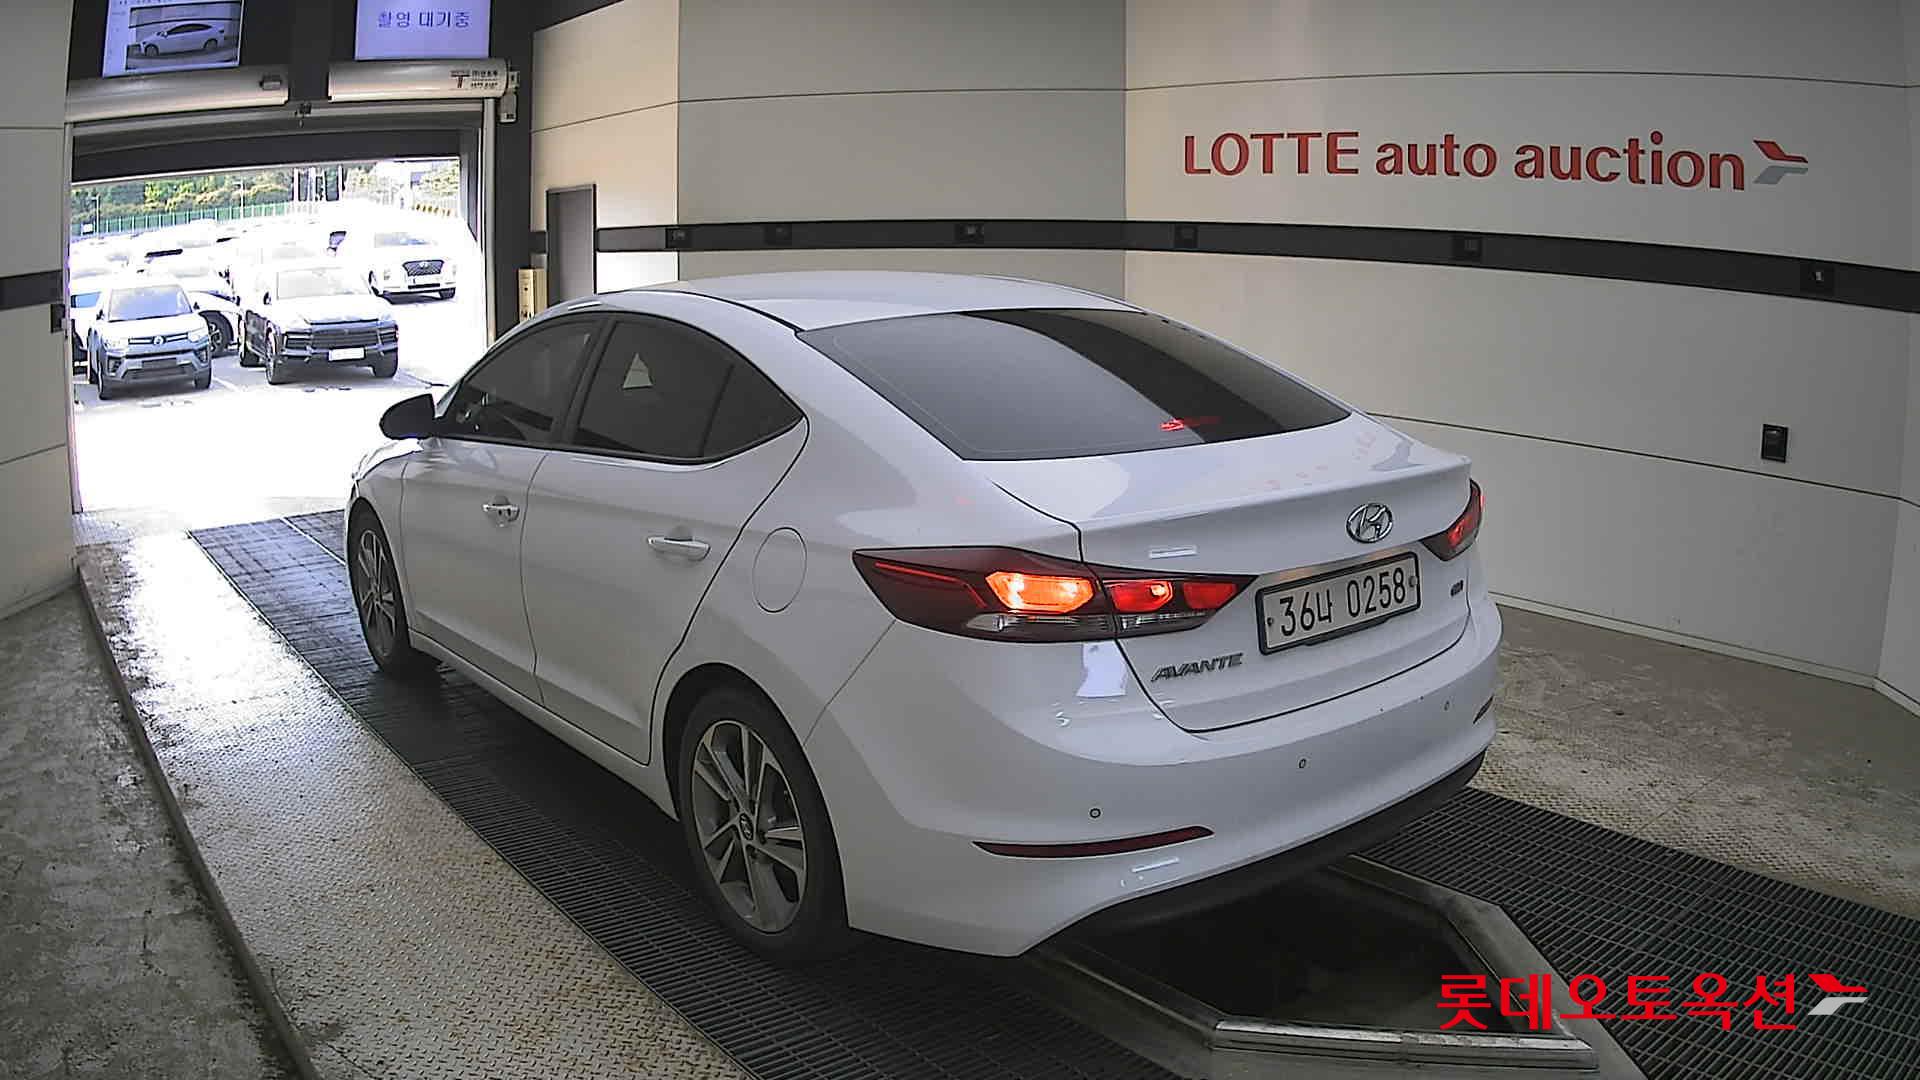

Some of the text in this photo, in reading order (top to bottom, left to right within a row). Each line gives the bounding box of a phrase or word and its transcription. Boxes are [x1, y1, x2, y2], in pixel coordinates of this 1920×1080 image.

[418, 11, 472, 29] 대기중
[1183, 131, 1745, 190] LOTTE auto auction
[1279, 567, 1406, 637] 36나 0258
[1150, 652, 1243, 683] AVANTE
